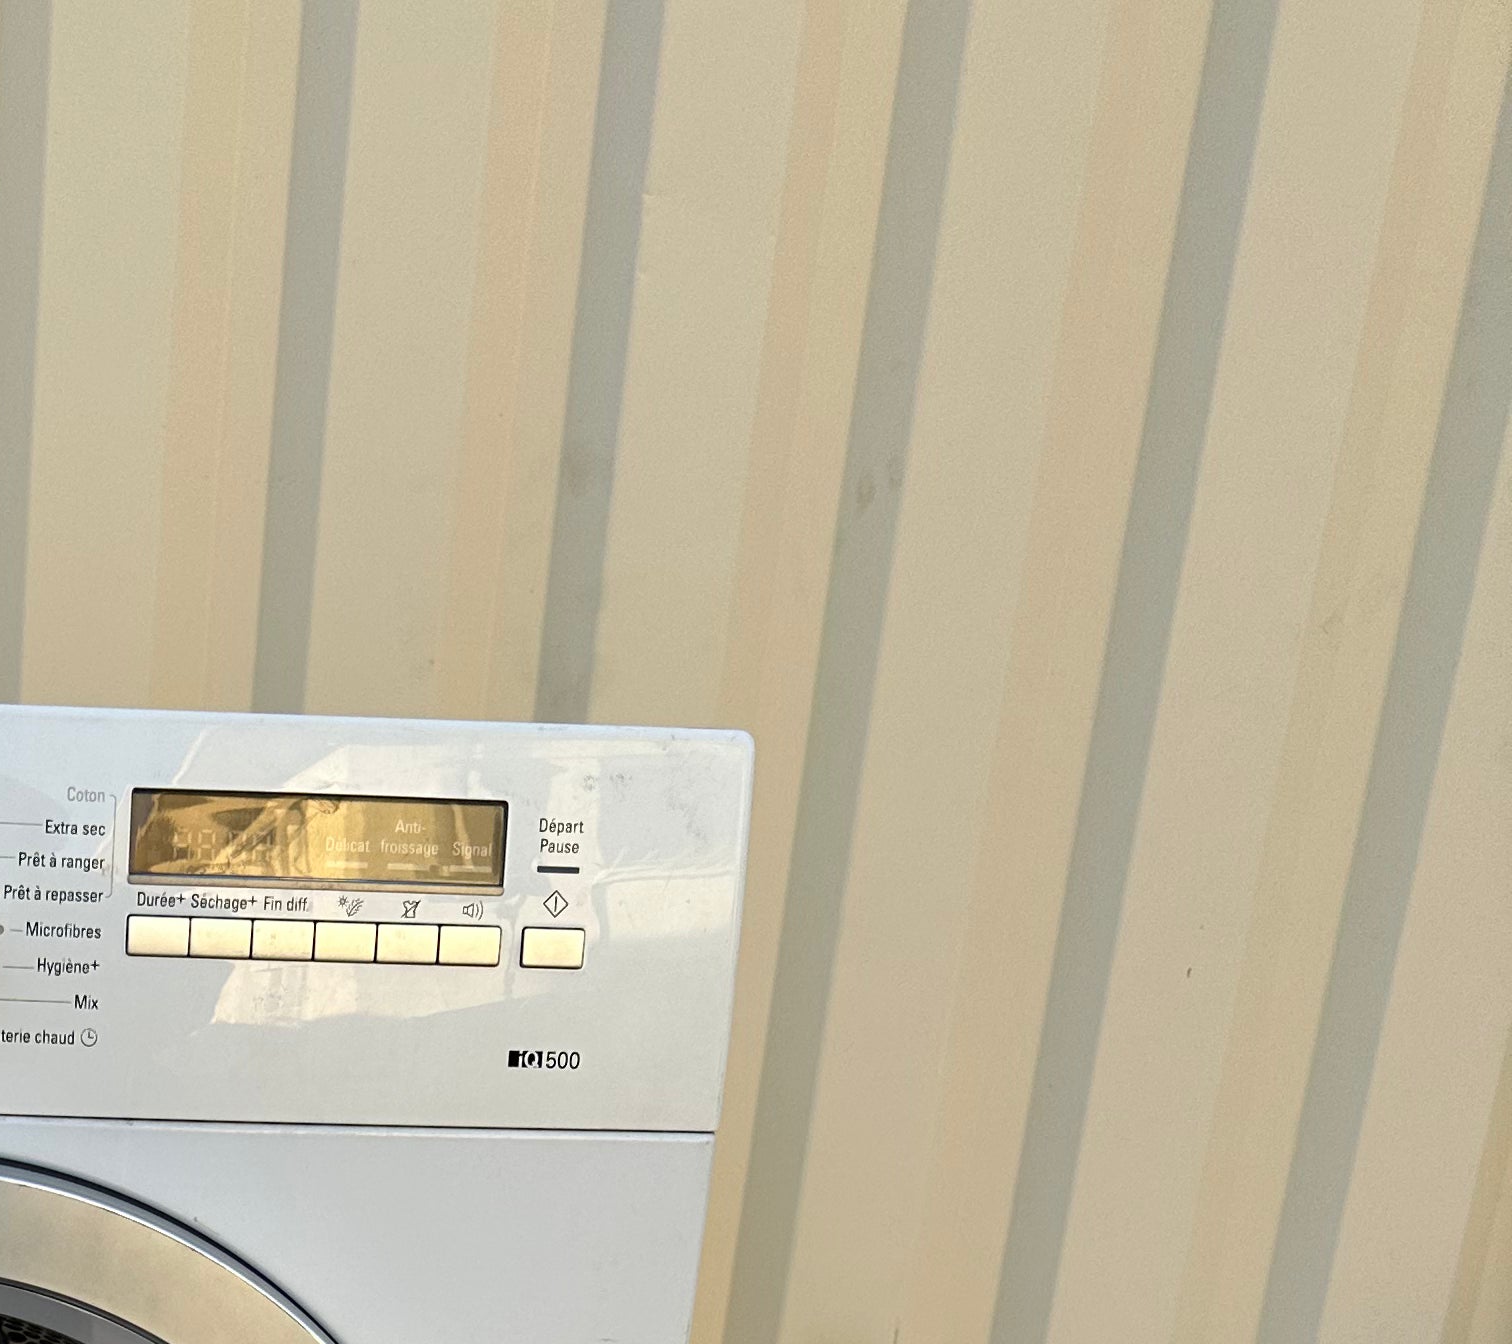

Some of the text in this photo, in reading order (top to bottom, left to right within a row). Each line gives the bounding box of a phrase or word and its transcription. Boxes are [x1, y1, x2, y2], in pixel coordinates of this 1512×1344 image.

[67, 786, 105, 802] Coton
[45, 819, 105, 835] Extra sec
[394, 819, 426, 833] Anti-
[539, 818, 584, 836] Départ
[380, 839, 438, 855] froissage
[451, 841, 492, 858] Signal
[540, 839, 580, 854] Pause
[18, 852, 105, 871] Prêt à ranger
[3, 884, 103, 903] Prêt à repasser
[136, 891, 186, 907] Durée+
[190, 893, 257, 911] Séchage+
[263, 895, 310, 911] Fin diff.
[25, 921, 101, 938] Microfibres
[37, 957, 100, 975] Hygiène+
[74, 993, 98, 1009] Mix
[34, 1028, 74, 1044] chaud
